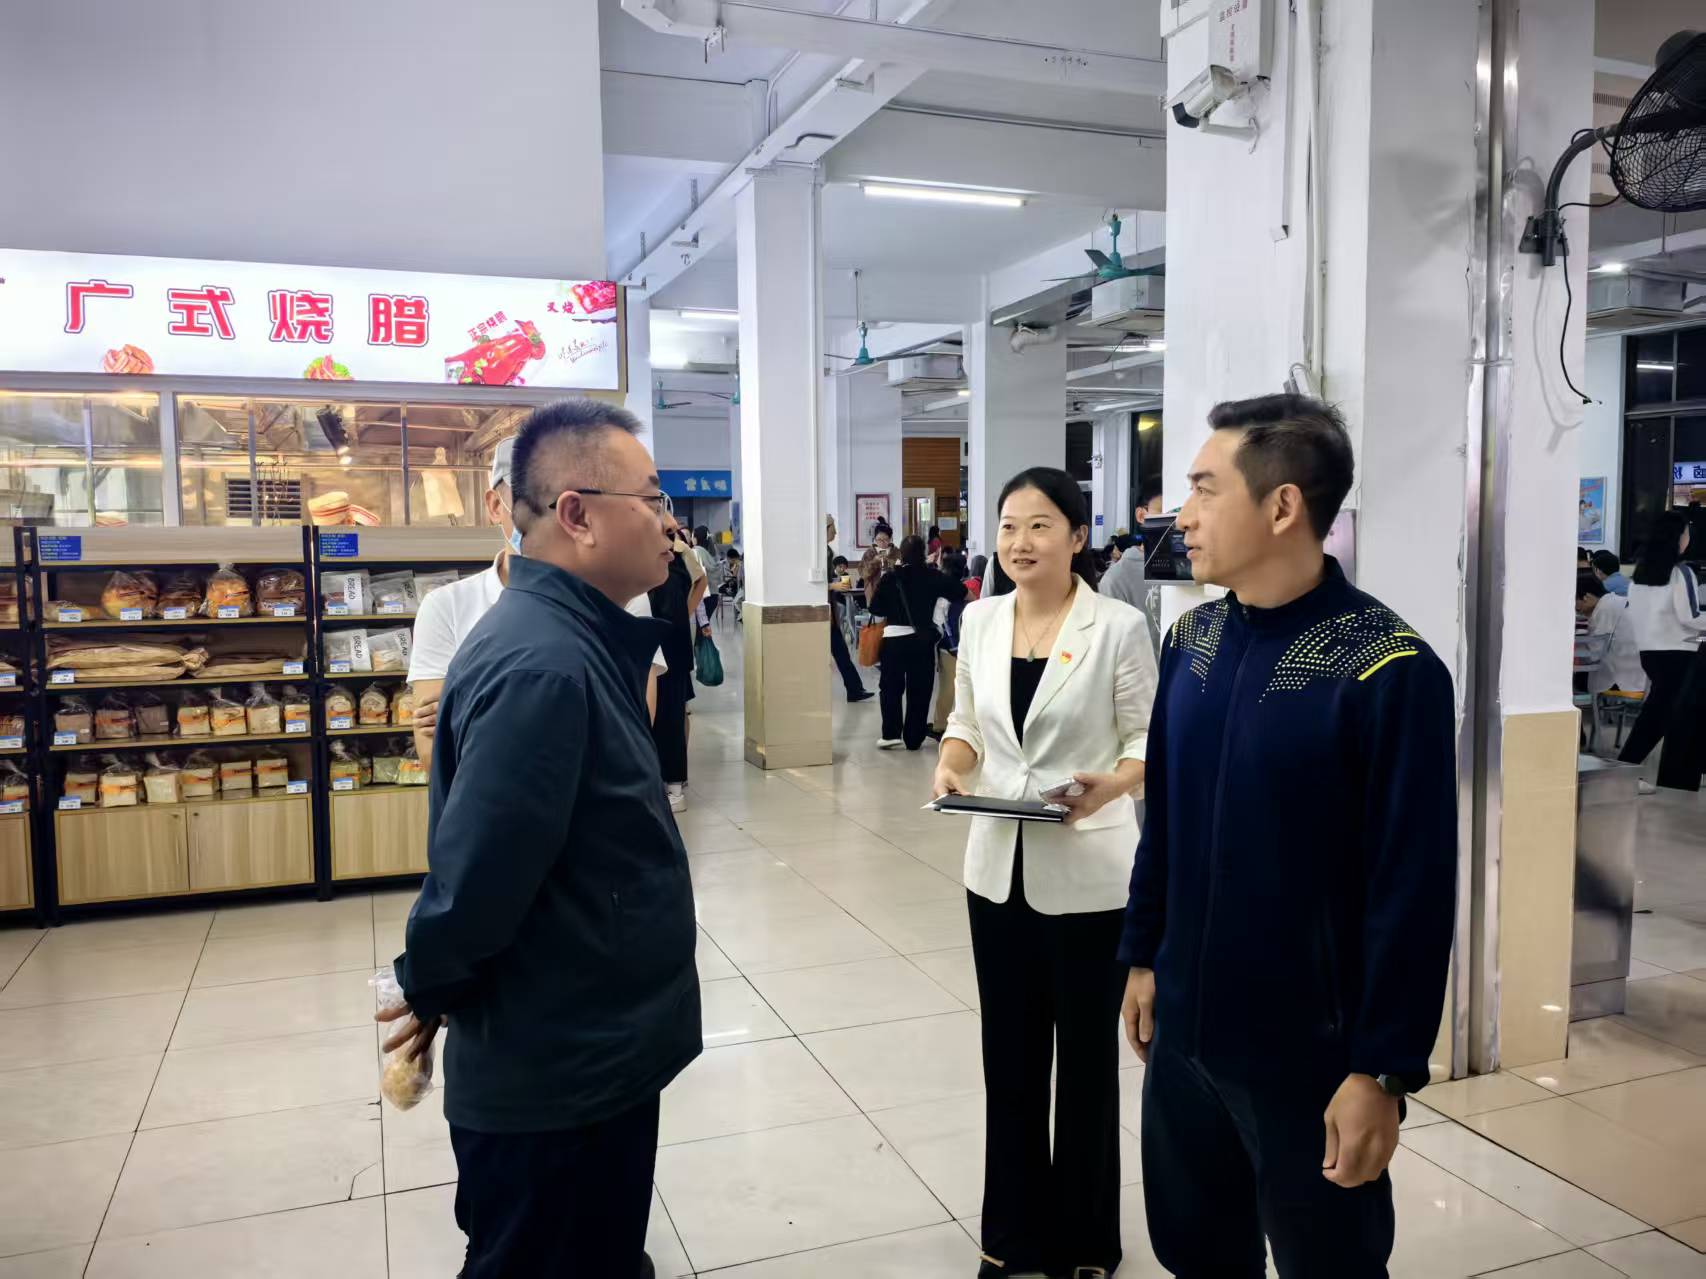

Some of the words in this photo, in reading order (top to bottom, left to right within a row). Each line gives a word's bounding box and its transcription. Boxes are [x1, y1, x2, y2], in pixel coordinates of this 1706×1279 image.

[64, 279, 430, 349] 广式烧腊
[347, 577, 356, 600] BREAD
[353, 635, 362, 659] BREAD
